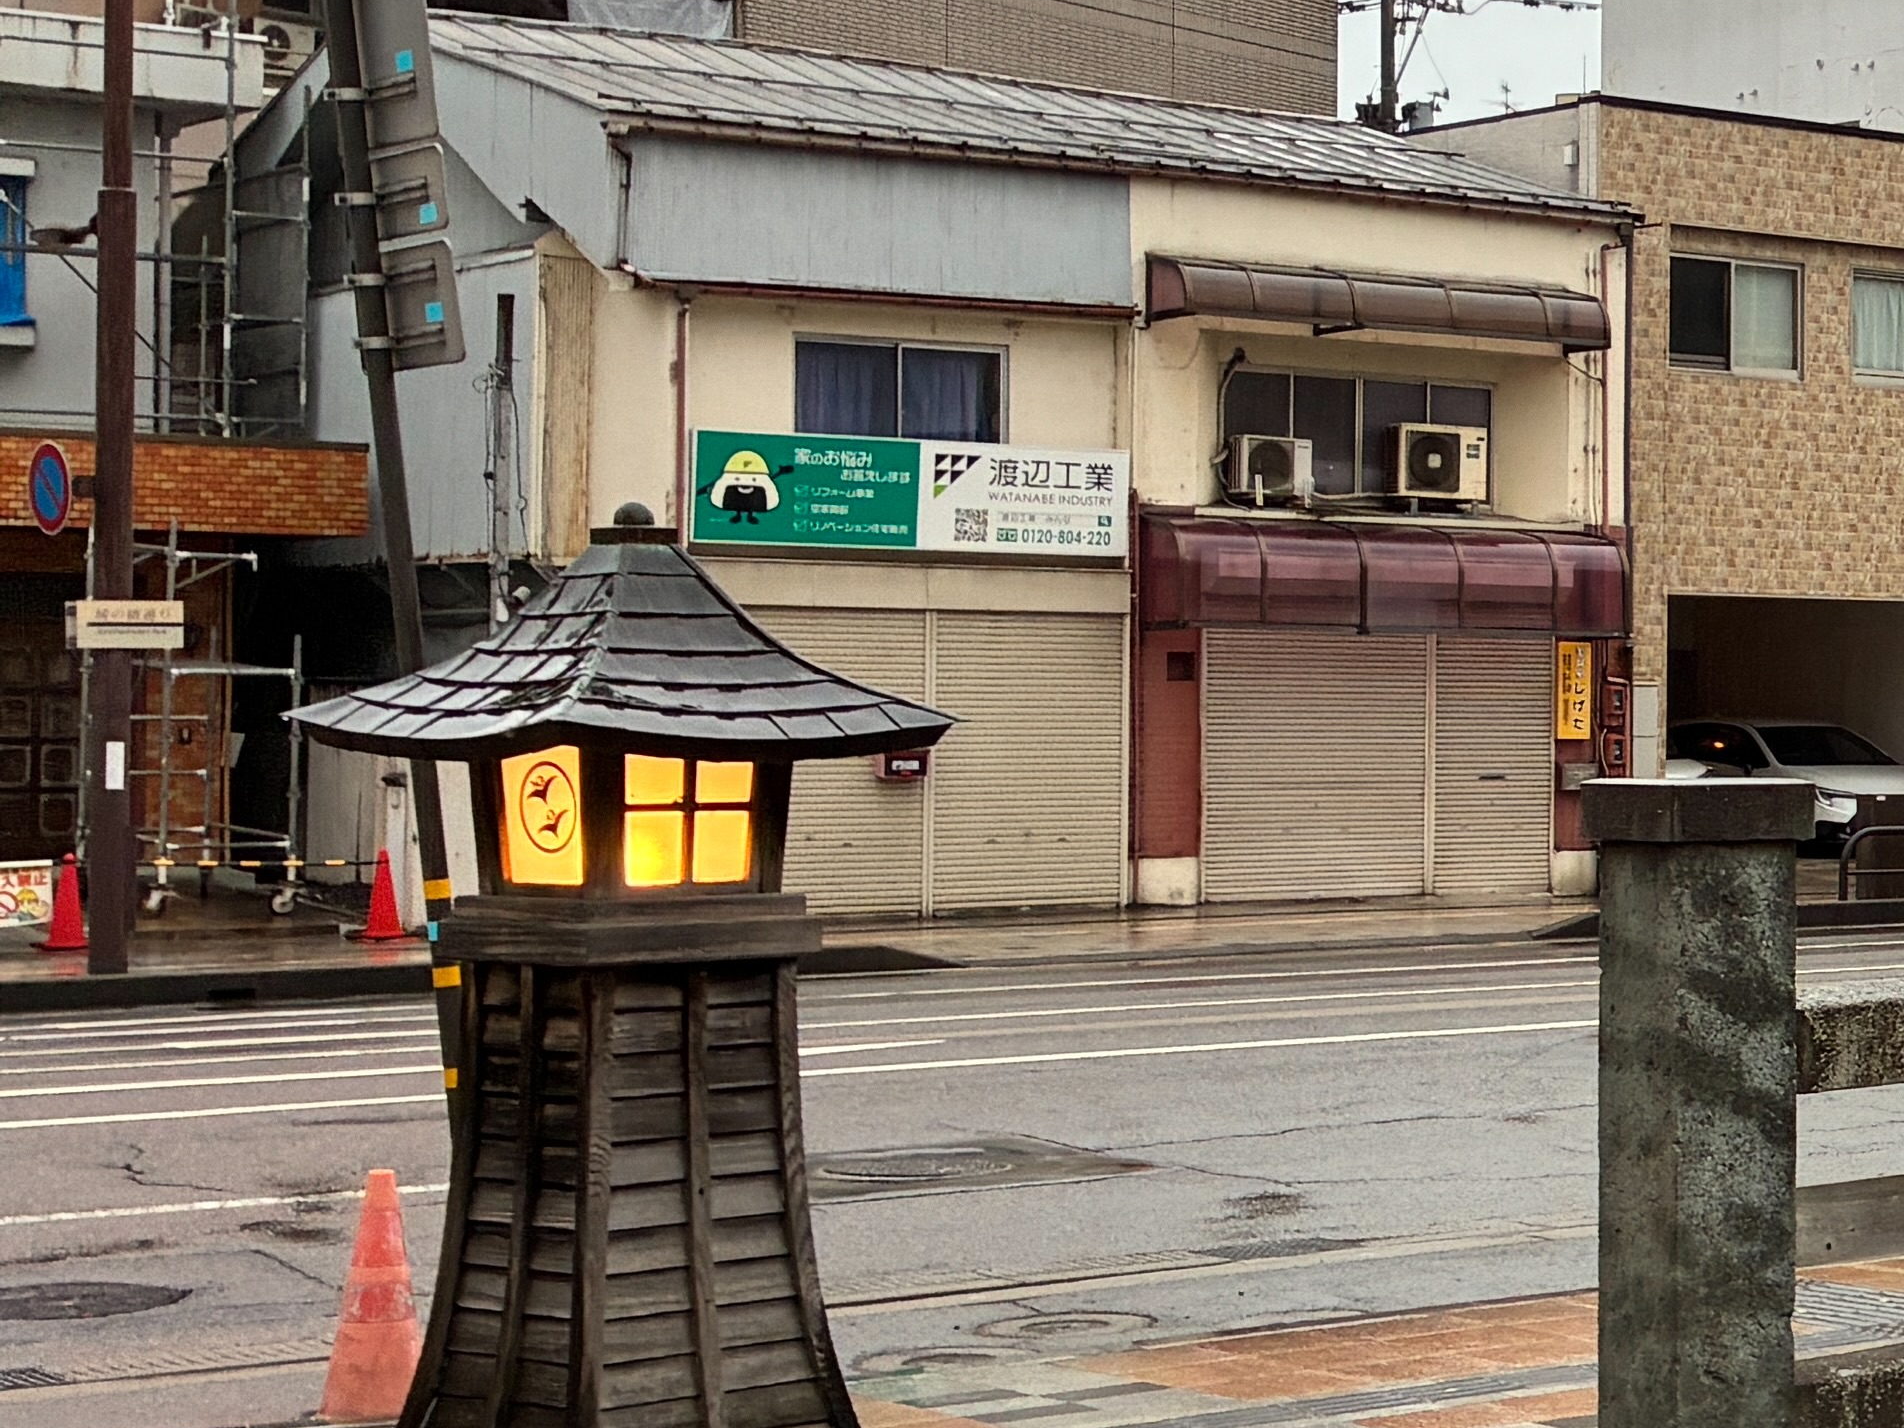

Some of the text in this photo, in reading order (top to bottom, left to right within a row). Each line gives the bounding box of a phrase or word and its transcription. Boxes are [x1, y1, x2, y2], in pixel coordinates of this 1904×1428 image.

[989, 457, 1114, 492] 渡辺工業
[988, 491, 1113, 507] WATANABE INDUSTRY
[1021, 528, 1111, 546] 0120-804-220
